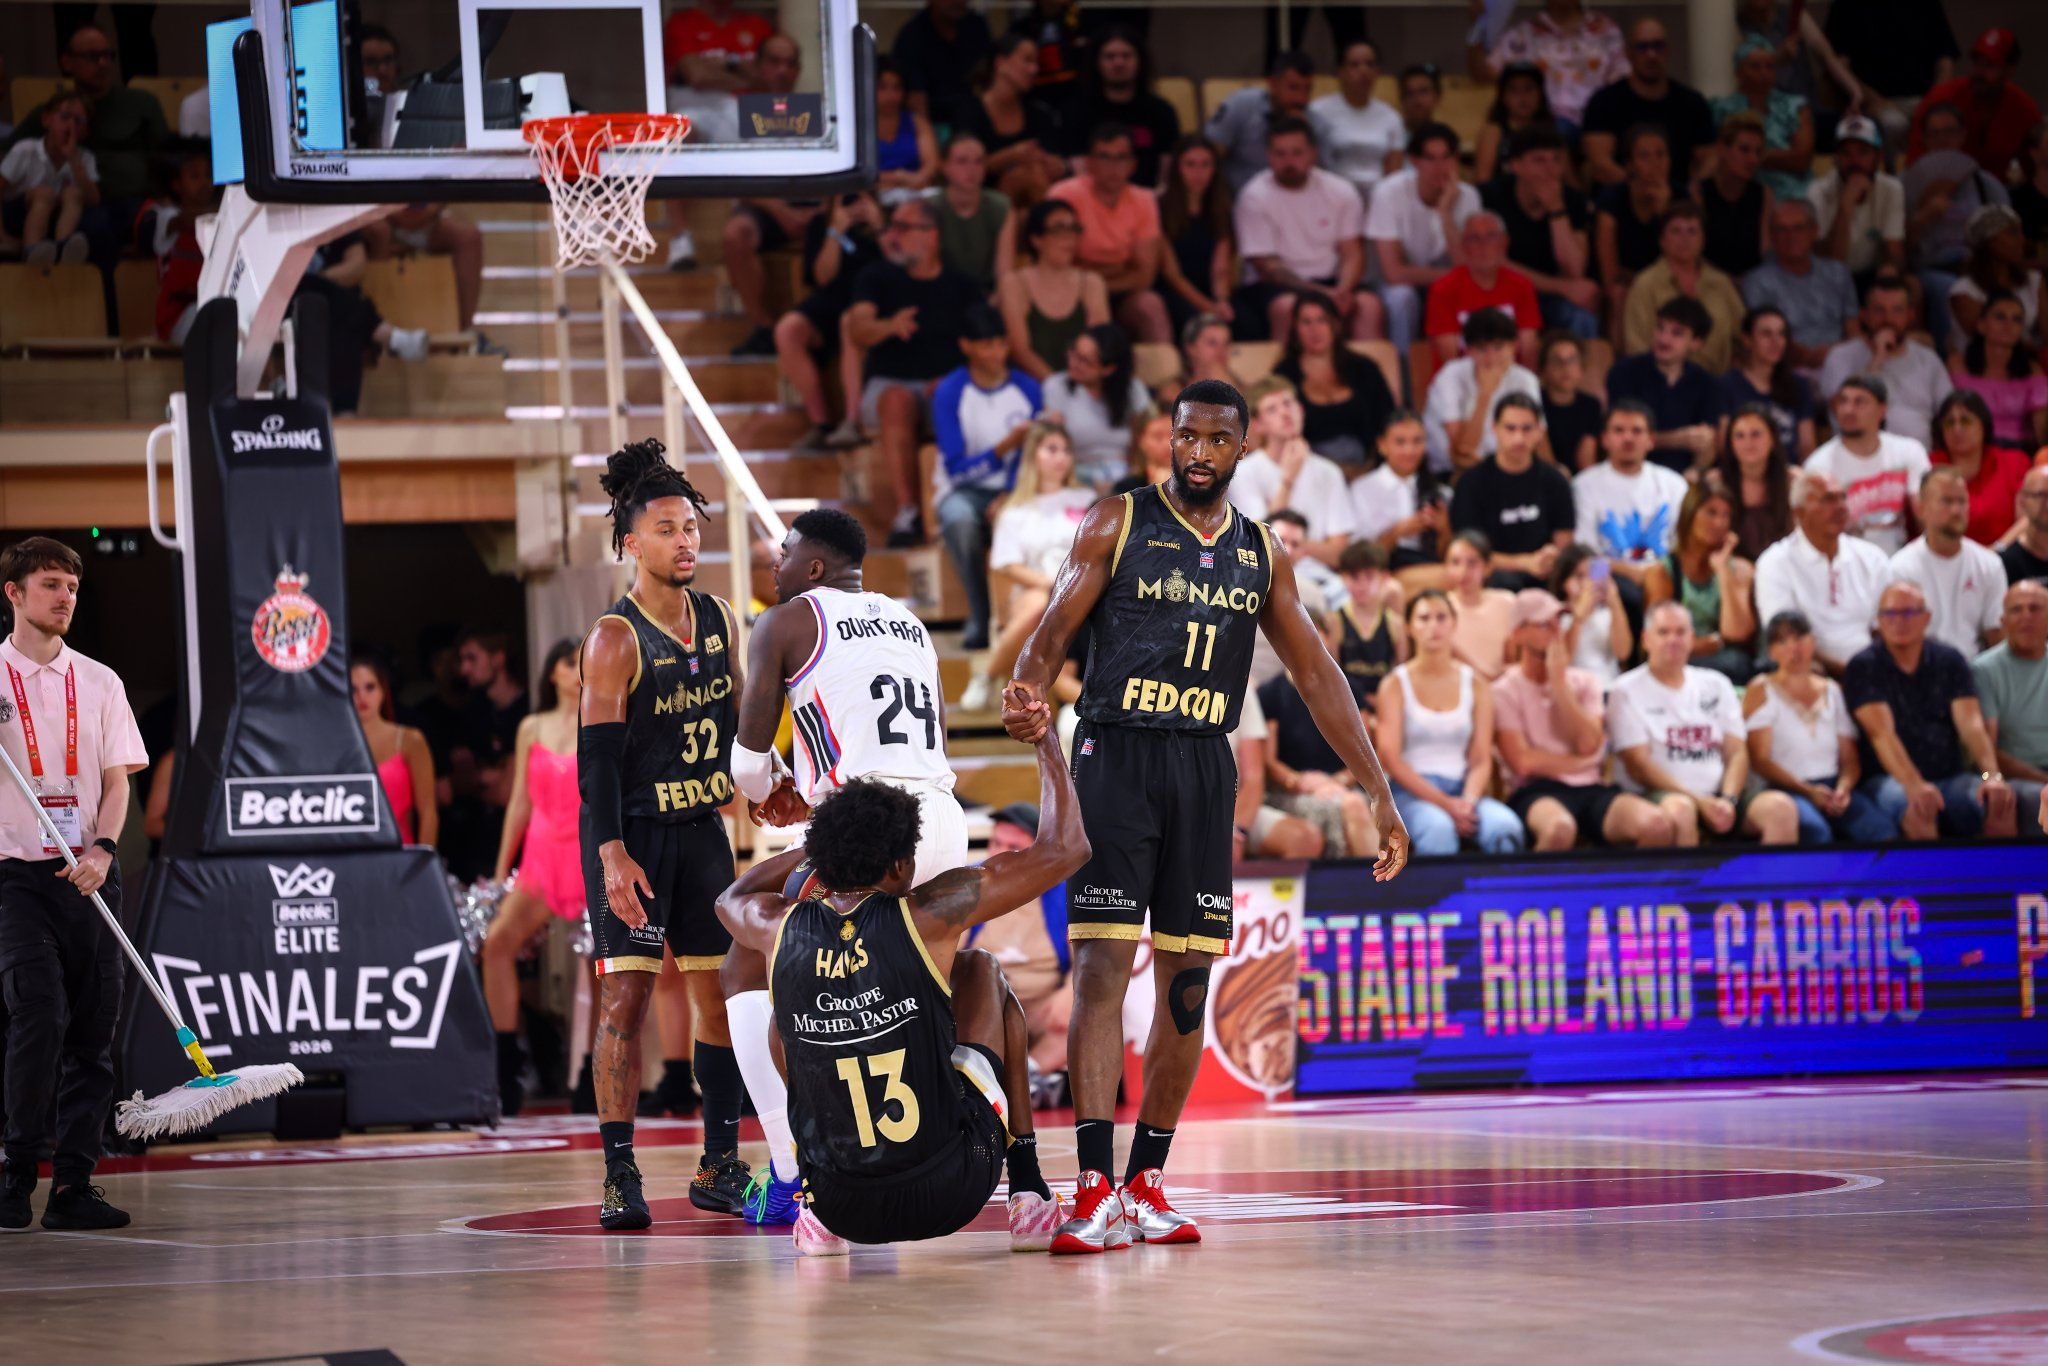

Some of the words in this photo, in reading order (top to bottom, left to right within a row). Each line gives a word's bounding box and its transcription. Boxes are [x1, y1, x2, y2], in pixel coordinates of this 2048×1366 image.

[290, 161, 348, 176] SPALDING
[231, 428, 322, 453] SPALDING
[1147, 539, 1181, 550] SPALDING
[1137, 574, 1259, 615] MONACO
[1183, 620, 1217, 671] 11
[870, 674, 936, 750] 24
[1122, 677, 1230, 726] FEDCON
[681, 718, 719, 764] 32
[239, 785, 366, 825] Betclic
[1073, 893, 1107, 905] MICHEL
[1107, 896, 1137, 908] PASTOR
[1084, 884, 1124, 897] GROUPE
[274, 925, 340, 954] ÉLITE
[1298, 912, 1464, 1043] STADE
[1481, 897, 1924, 1037] ROLAND-GARROS
[183, 966, 428, 1040] FINALES
[794, 1013, 859, 1034] MICHEL
[859, 997, 919, 1031] PASTOR
[816, 987, 885, 1012] GROUPE
[289, 1039, 333, 1055] 2026
[835, 1048, 920, 1148] 13
